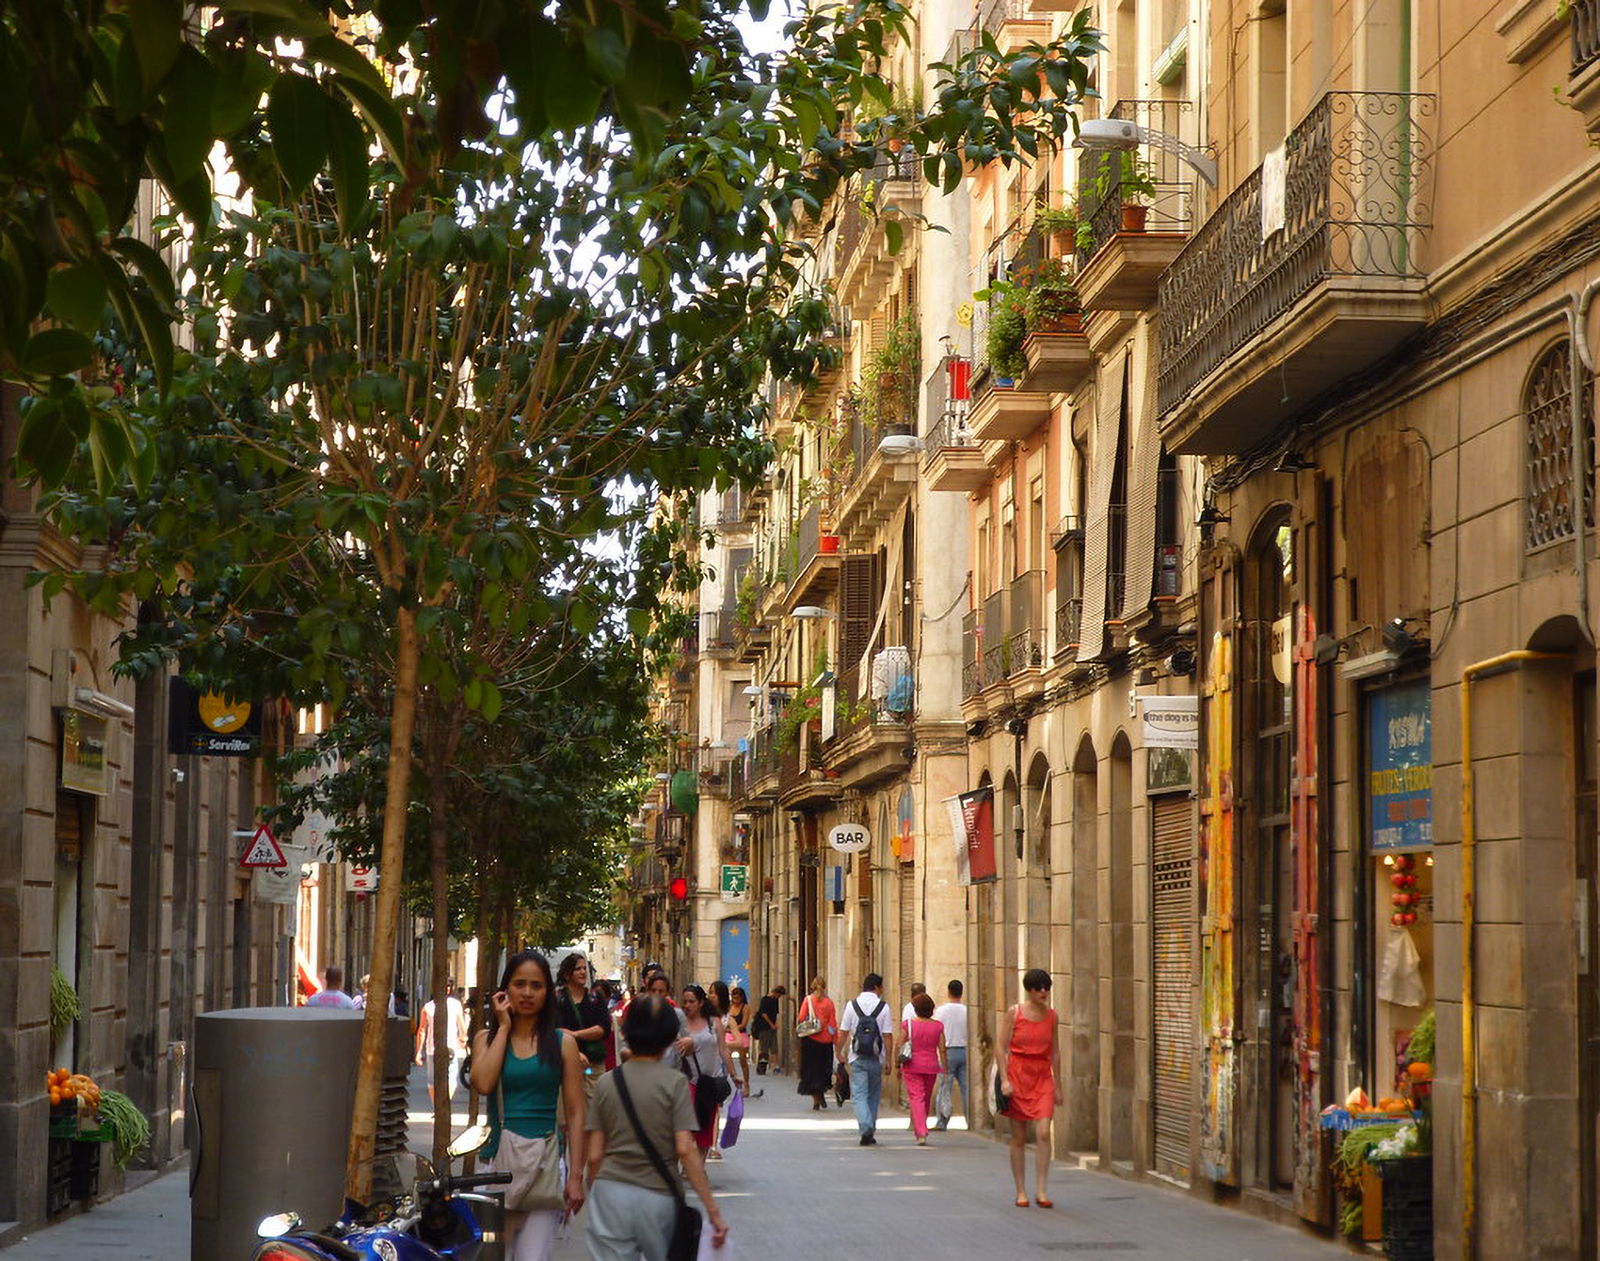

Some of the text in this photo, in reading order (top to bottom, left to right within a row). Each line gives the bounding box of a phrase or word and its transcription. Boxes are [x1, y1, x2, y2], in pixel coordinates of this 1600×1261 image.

[1149, 713, 1163, 722] the
[1164, 713, 1181, 724] dog
[836, 832, 864, 844] BAR
